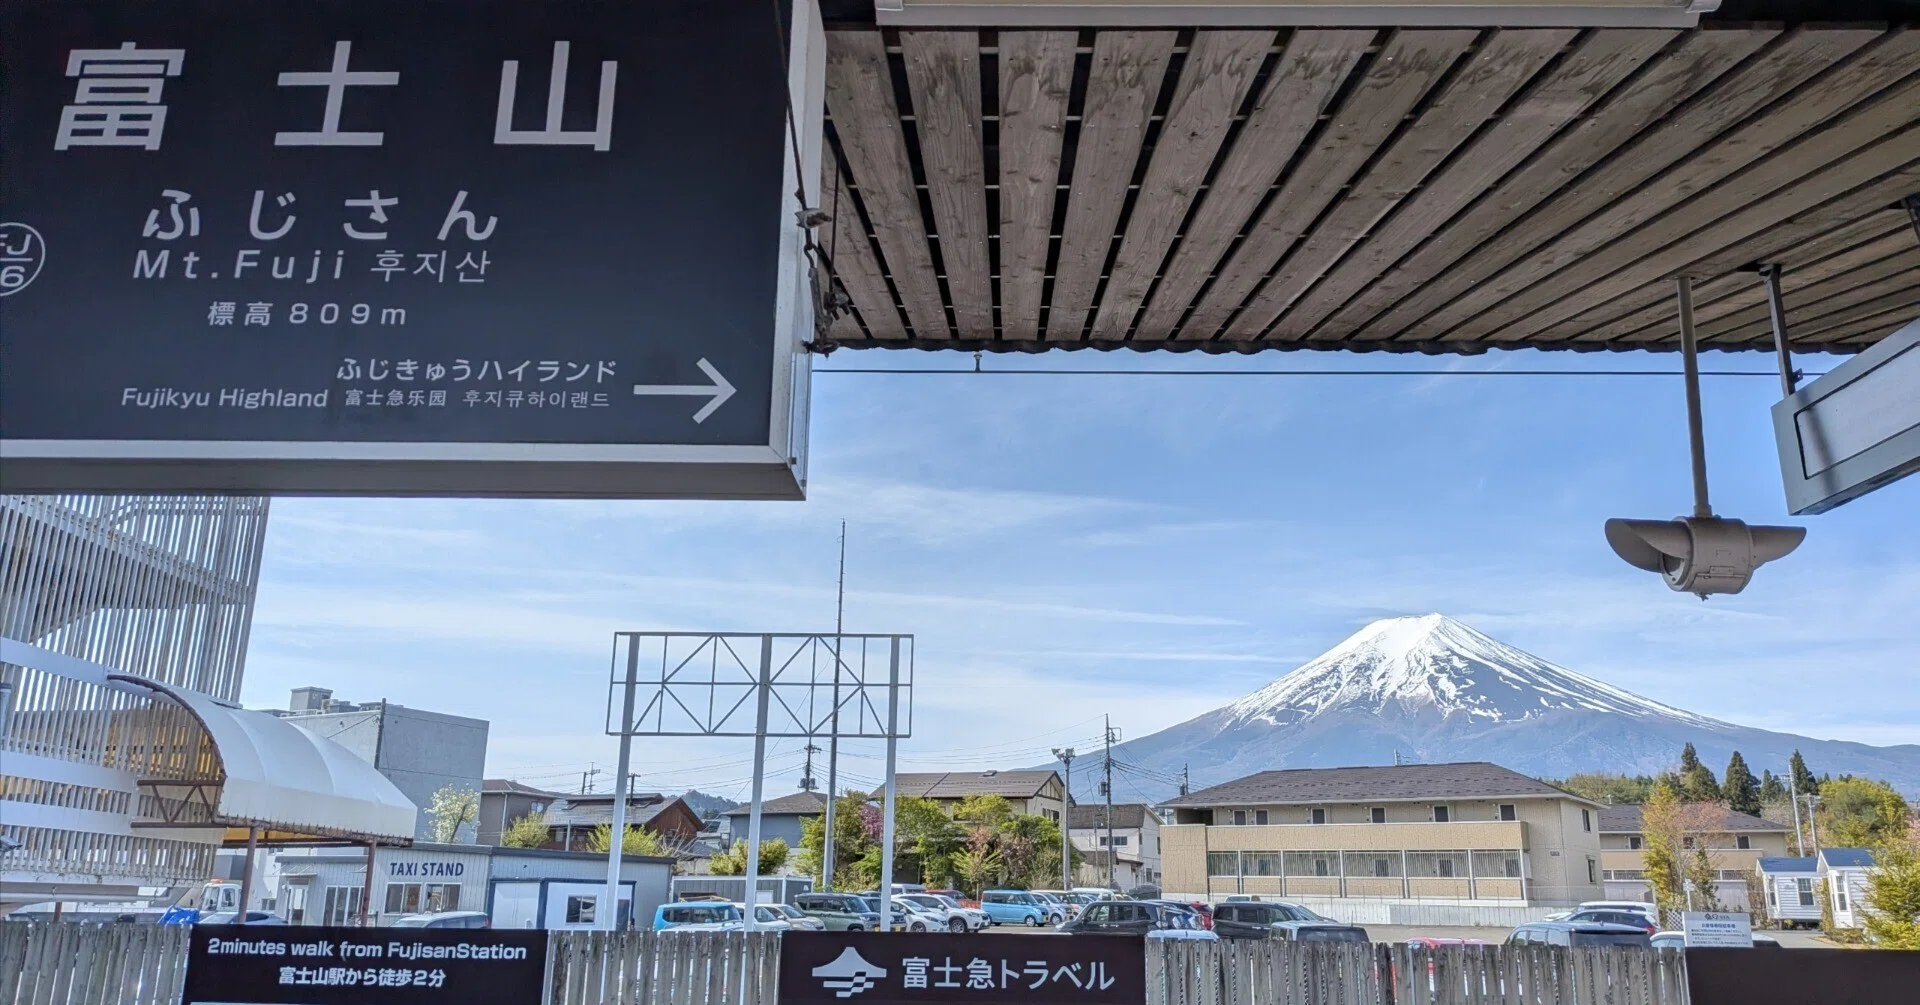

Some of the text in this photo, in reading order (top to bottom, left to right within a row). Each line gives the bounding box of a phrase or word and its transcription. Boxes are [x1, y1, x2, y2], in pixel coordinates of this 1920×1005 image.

[54, 40, 619, 152] 富士山
[142, 189, 498, 241] ふじさん
[132, 249, 345, 283] Mt.Fuji
[370, 250, 492, 283] 후지산
[336, 358, 617, 383] ふじきゅうハイランド
[121, 387, 329, 409] Fujikyu Highland
[345, 389, 447, 407] 富士急乐园
[462, 390, 610, 409] 후지큐하이랜드
[390, 862, 464, 877] TAXI STAND
[208, 938, 527, 961] 2minutes walk from FujisanStation
[902, 956, 1116, 990] 富士急トラベル
